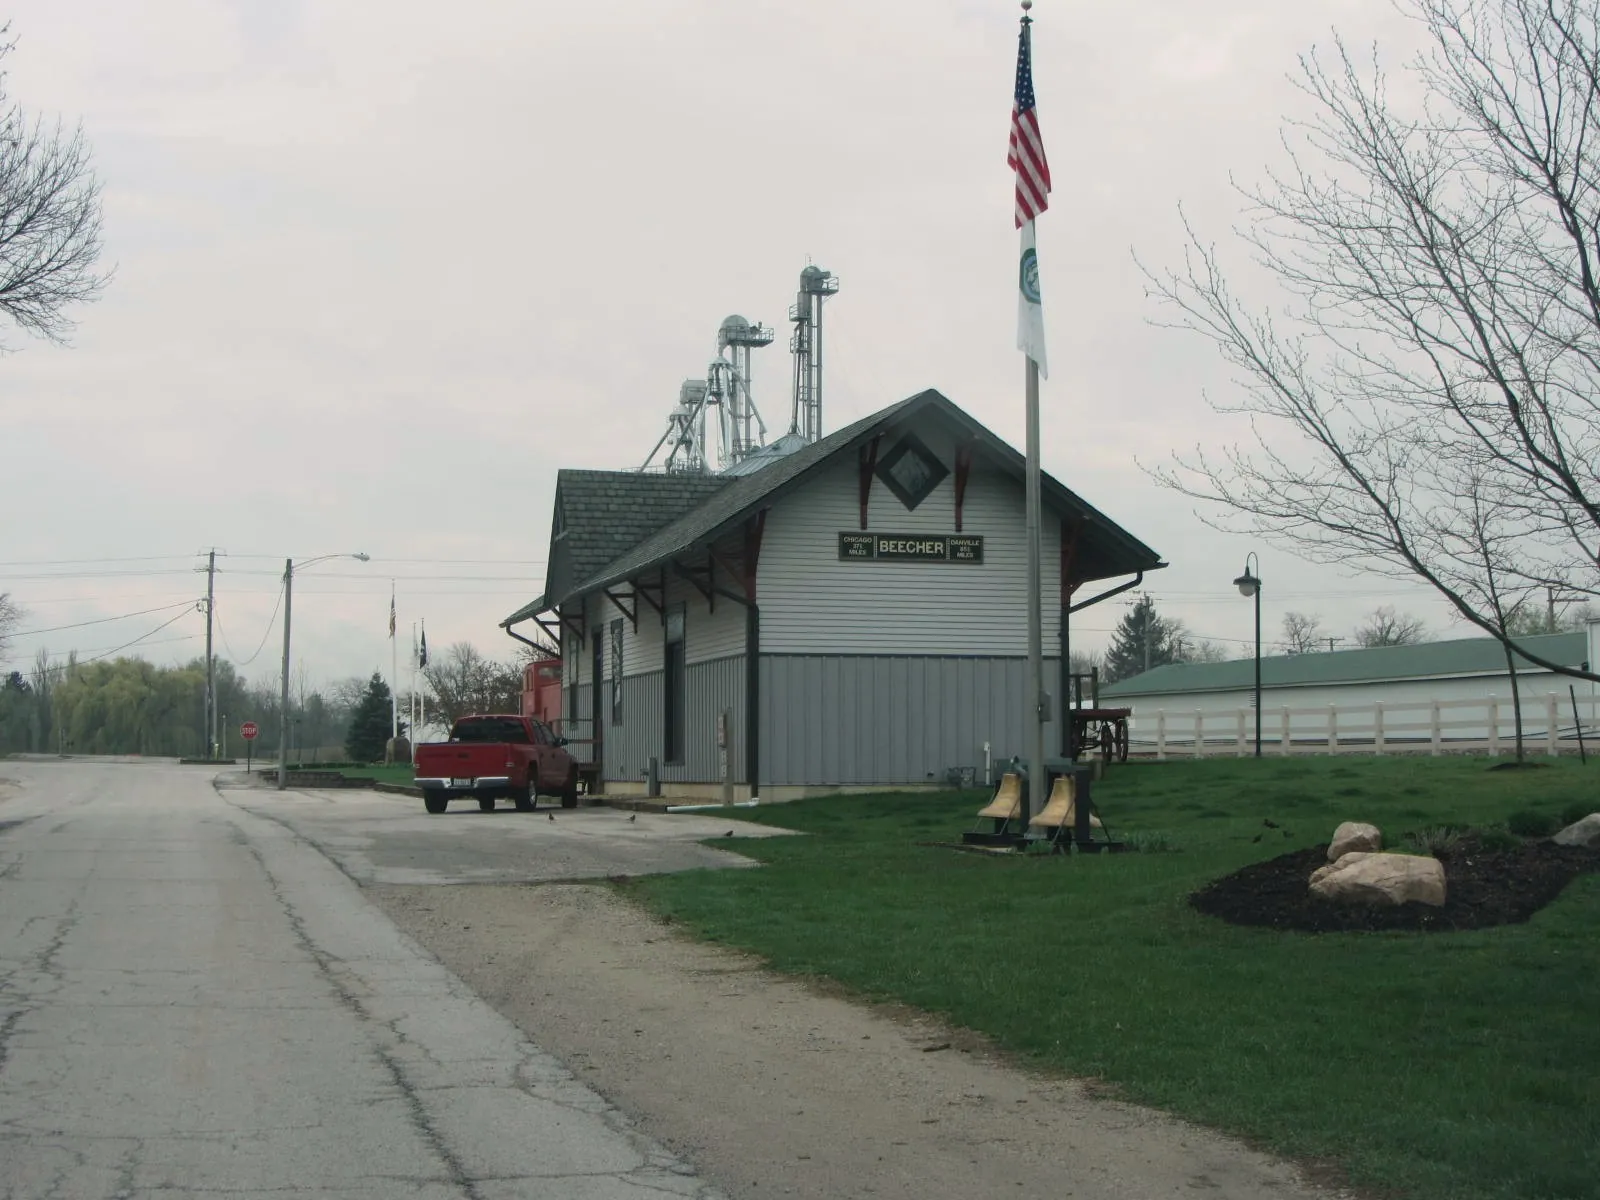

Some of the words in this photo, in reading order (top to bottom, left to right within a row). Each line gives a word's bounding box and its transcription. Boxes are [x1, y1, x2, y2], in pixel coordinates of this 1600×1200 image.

[843, 536, 872, 544] CHICAGO
[879, 540, 944, 554] BEECHER
[241, 727, 257, 735] STOP
